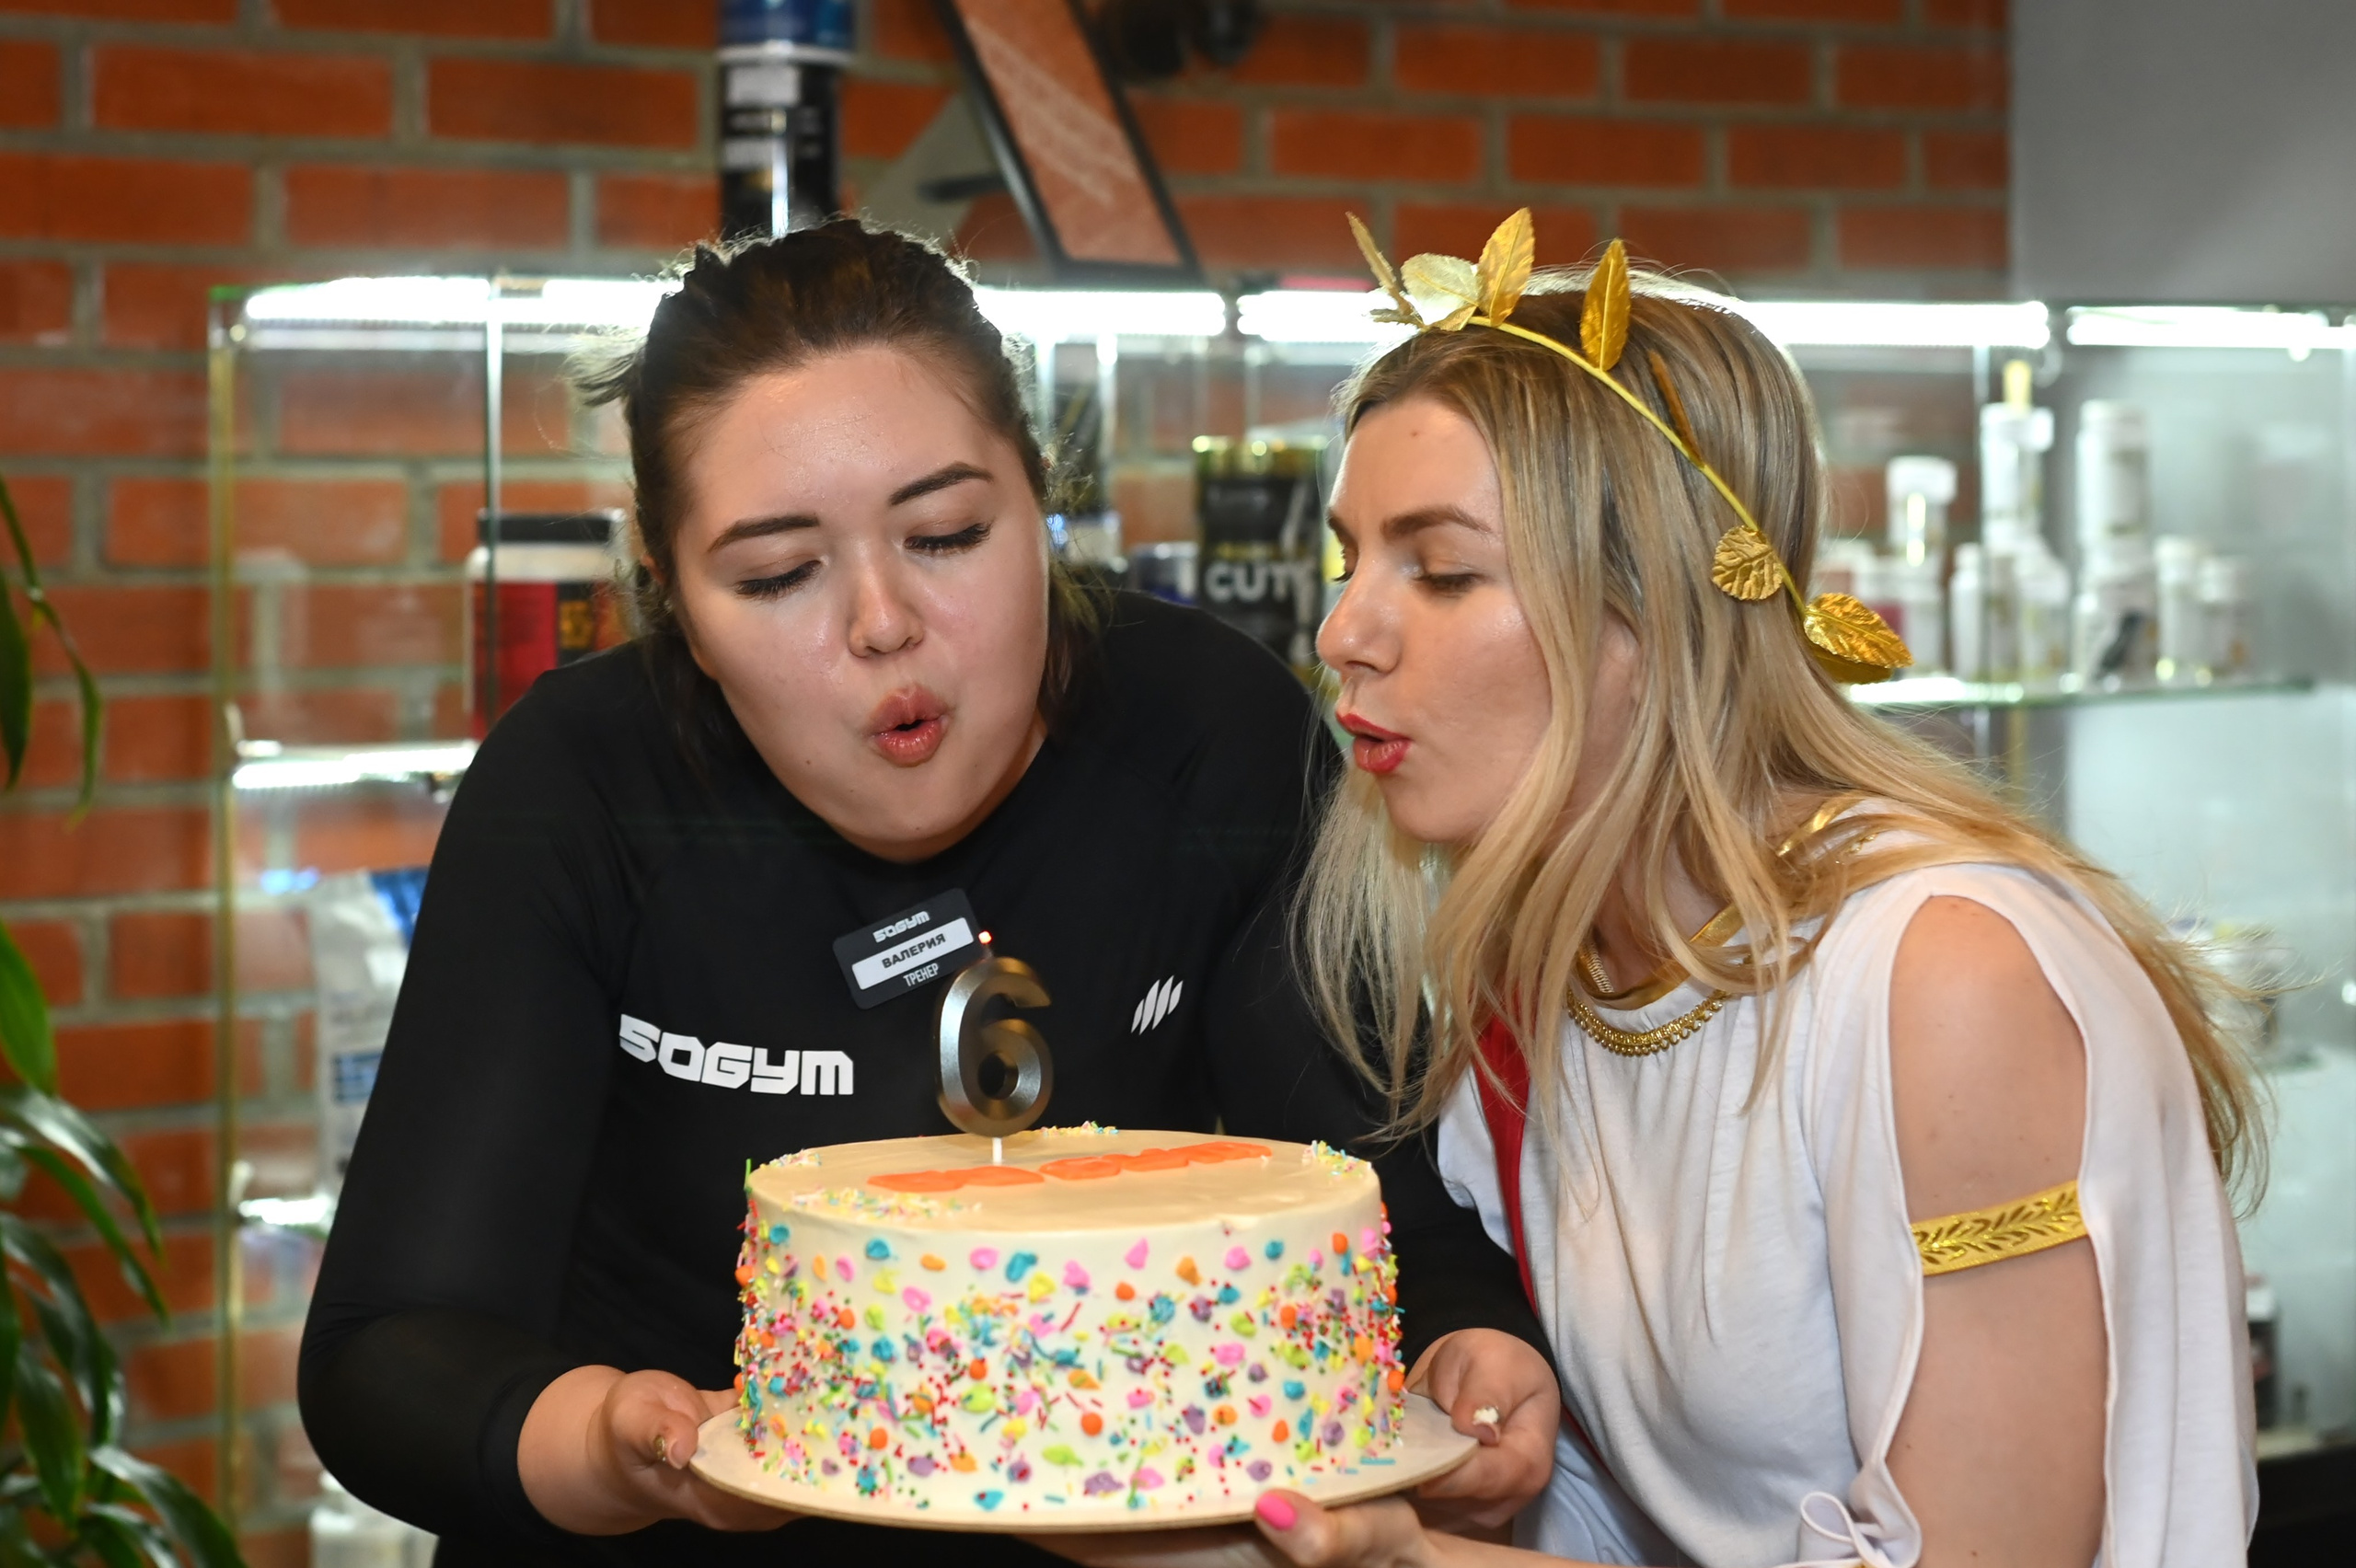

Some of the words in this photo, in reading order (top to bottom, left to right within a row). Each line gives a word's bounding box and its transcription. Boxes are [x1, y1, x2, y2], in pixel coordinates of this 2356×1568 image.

[872, 911, 930, 943] SOGYM
[882, 933, 946, 969] ВАЛЕРИЯ
[903, 963, 940, 987] ТРЕНЕР
[618, 1013, 854, 1096] SOGYM
[936, 956, 1054, 1137] 6
